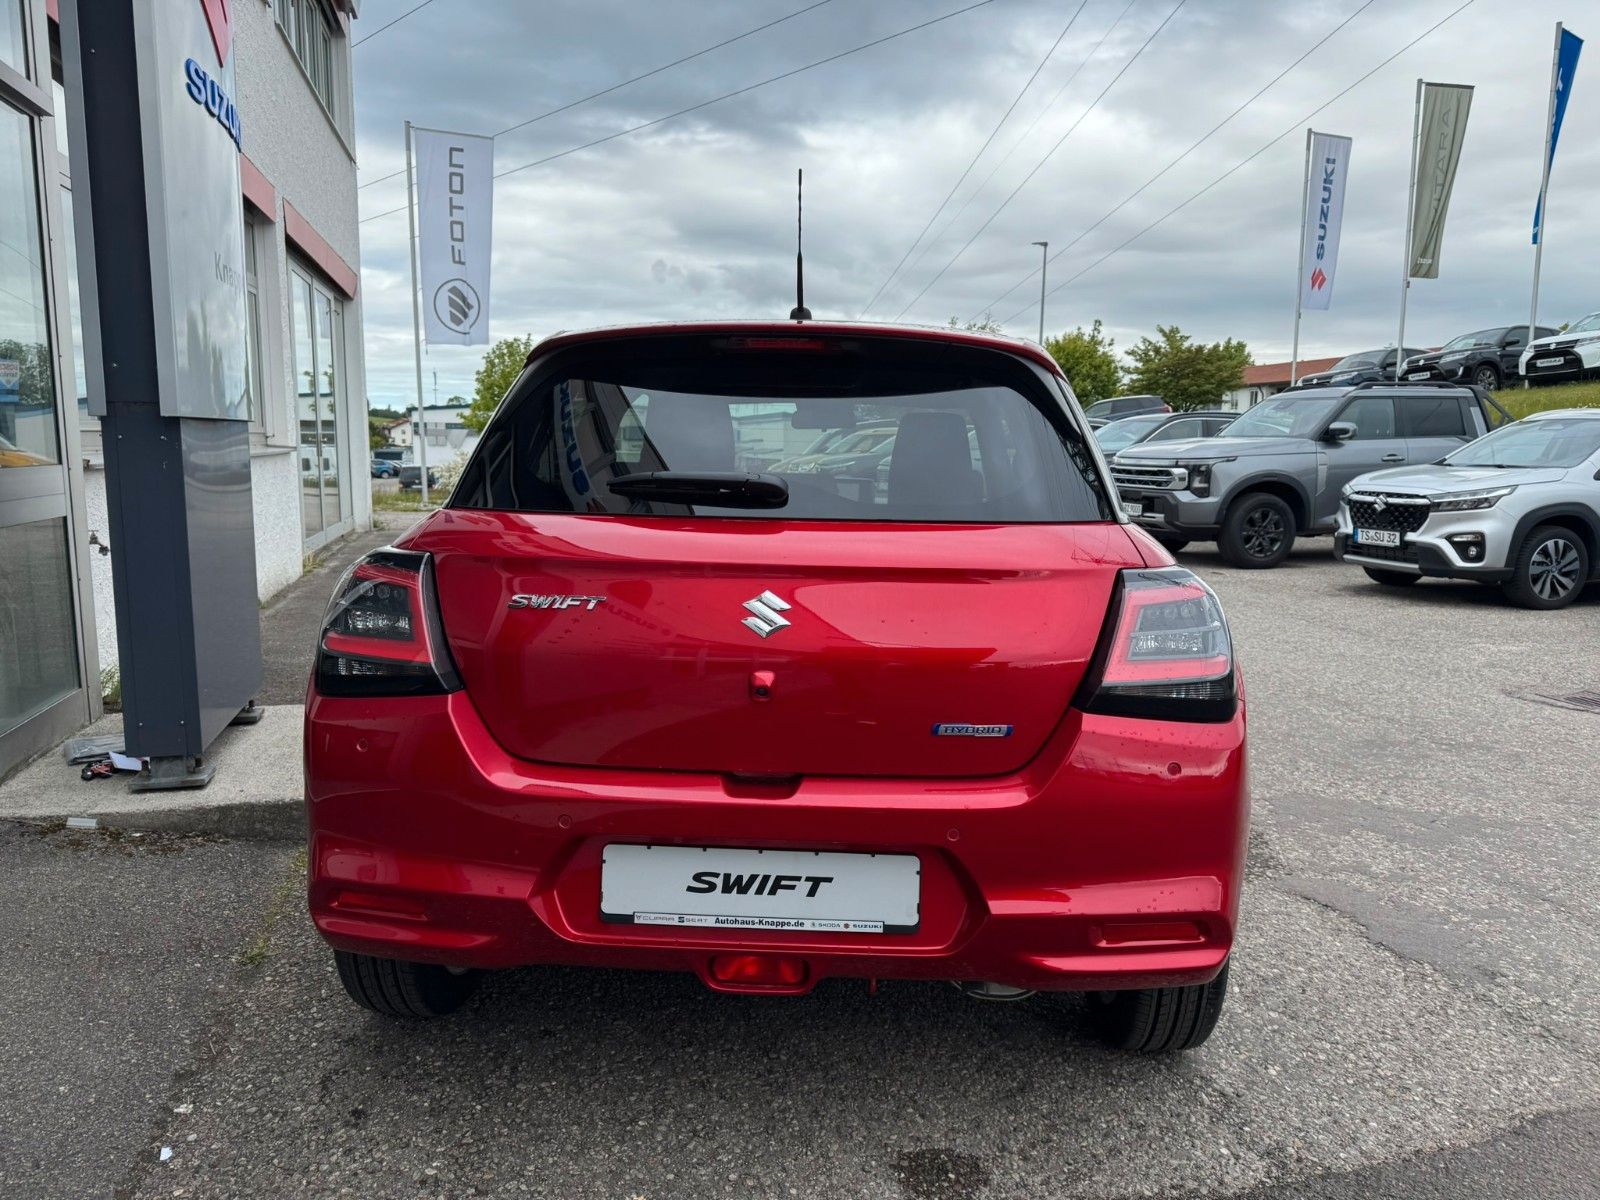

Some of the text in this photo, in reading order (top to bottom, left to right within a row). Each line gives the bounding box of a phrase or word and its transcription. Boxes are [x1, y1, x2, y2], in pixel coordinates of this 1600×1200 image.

[449, 146, 466, 266] FOTON
[1316, 157, 1336, 261] SUZUKI
[507, 594, 607, 611] SWIFT
[942, 725, 1004, 735] HYBRID
[686, 871, 834, 898] SWIFT
[714, 916, 806, 929] Autohaus-Knappe.de
